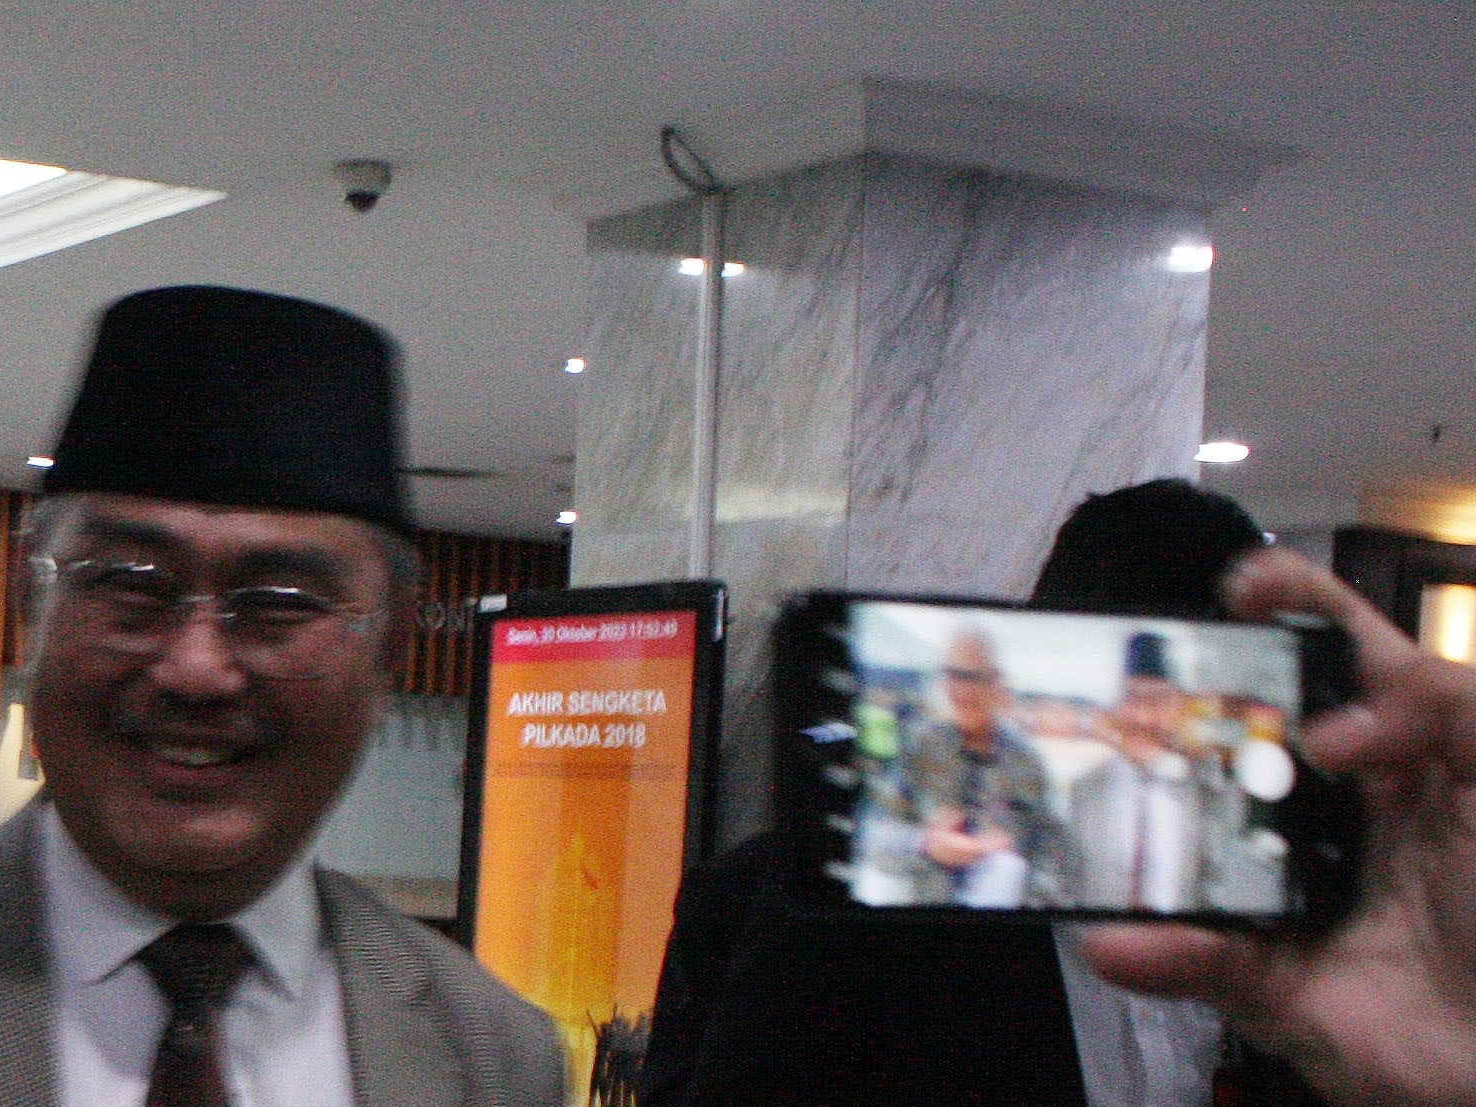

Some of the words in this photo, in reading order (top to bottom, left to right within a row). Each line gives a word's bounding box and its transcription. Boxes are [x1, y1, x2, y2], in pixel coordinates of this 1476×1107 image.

[557, 623, 598, 643] Oktober
[508, 692, 563, 715] AKHIR
[568, 689, 667, 714] SENGKETA
[522, 724, 601, 748] PILKADA
[603, 723, 646, 747] 2018
